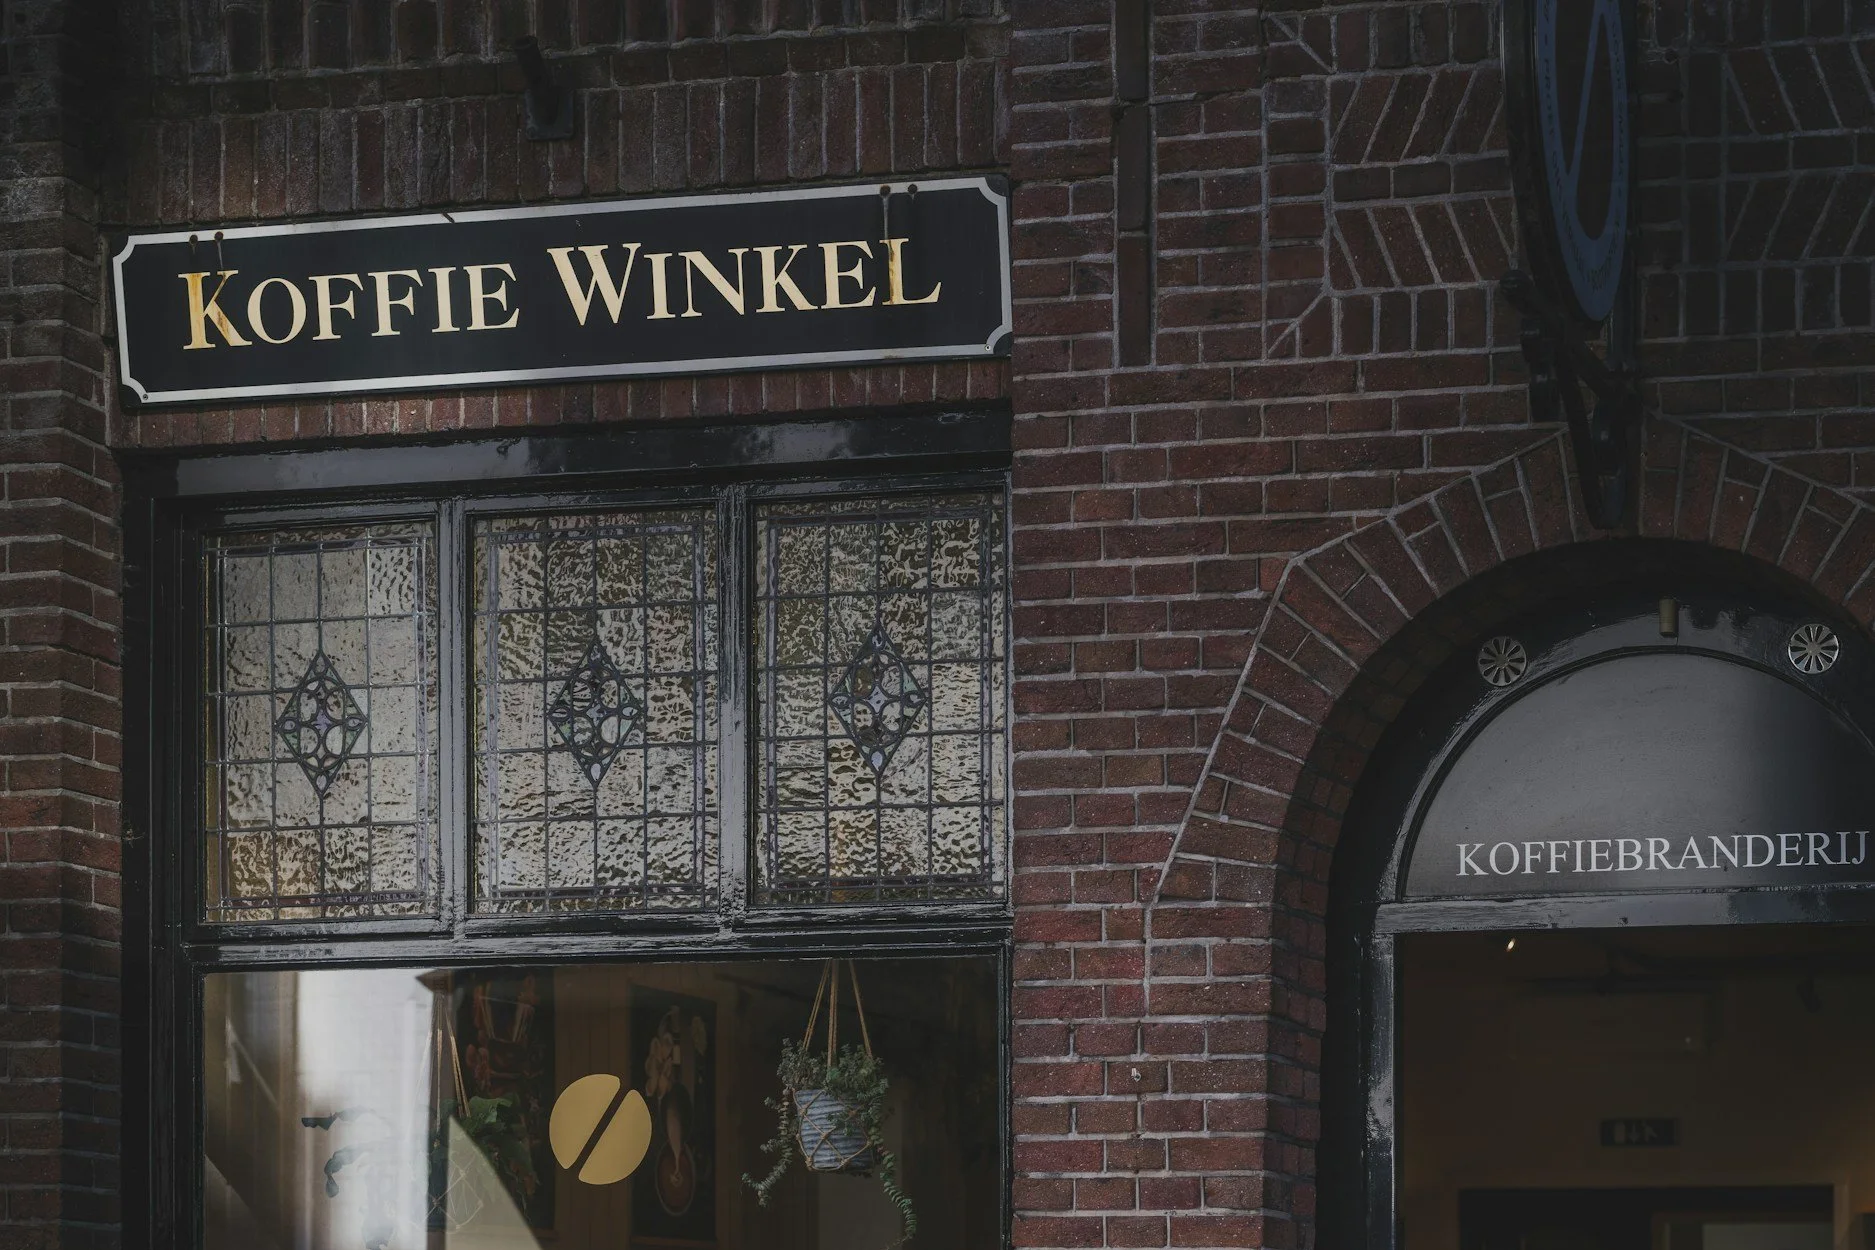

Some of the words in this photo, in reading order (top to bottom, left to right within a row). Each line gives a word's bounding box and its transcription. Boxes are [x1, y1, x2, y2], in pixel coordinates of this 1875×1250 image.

[178, 263, 520, 350] KOFFIE
[547, 237, 942, 326] WINKEL
[1455, 830, 1870, 877] KOFFIEBRANDERIJ
